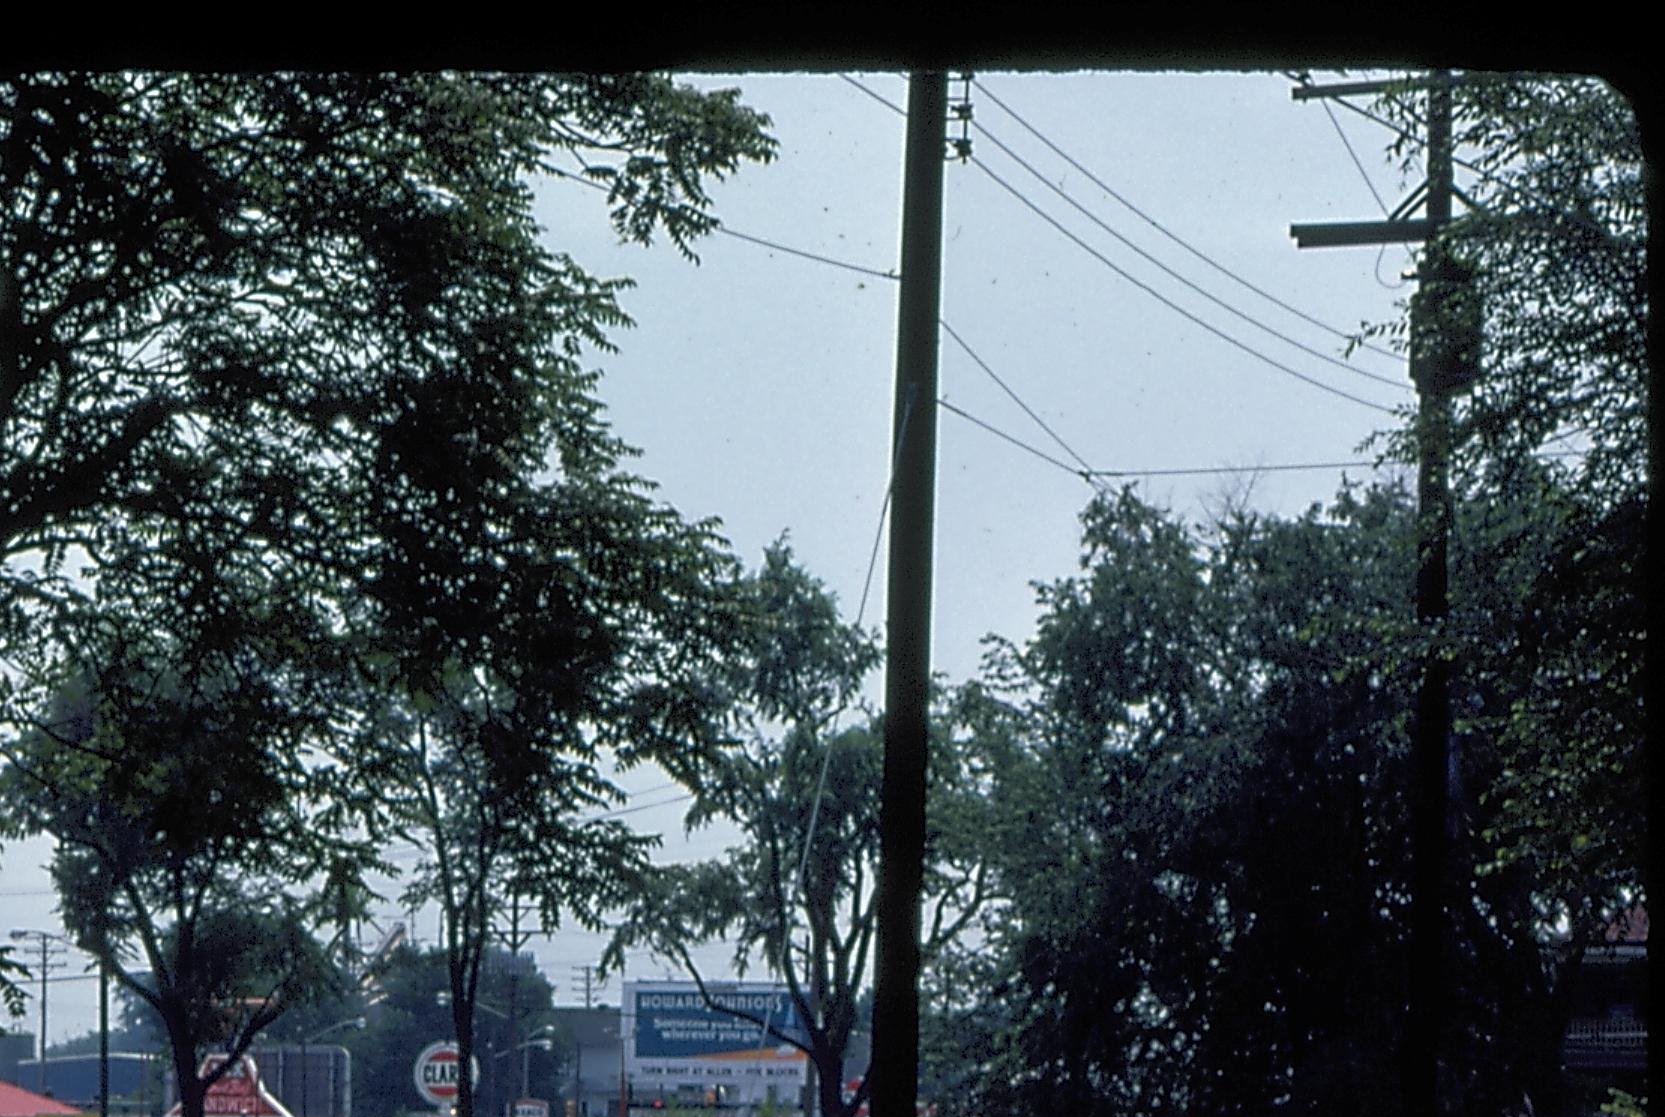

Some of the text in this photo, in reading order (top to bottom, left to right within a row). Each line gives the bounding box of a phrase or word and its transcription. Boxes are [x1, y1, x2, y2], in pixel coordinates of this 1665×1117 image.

[641, 994, 704, 1009] HOWARD
[653, 1018, 708, 1029] Someone
[710, 1021, 732, 1031] you
[661, 1029, 717, 1039] wherever
[718, 1030, 740, 1041] you
[423, 1064, 458, 1084] CLAR
[642, 1066, 663, 1075] TURN
[666, 1066, 689, 1075] RIGHT
[693, 1067, 703, 1076] AT
